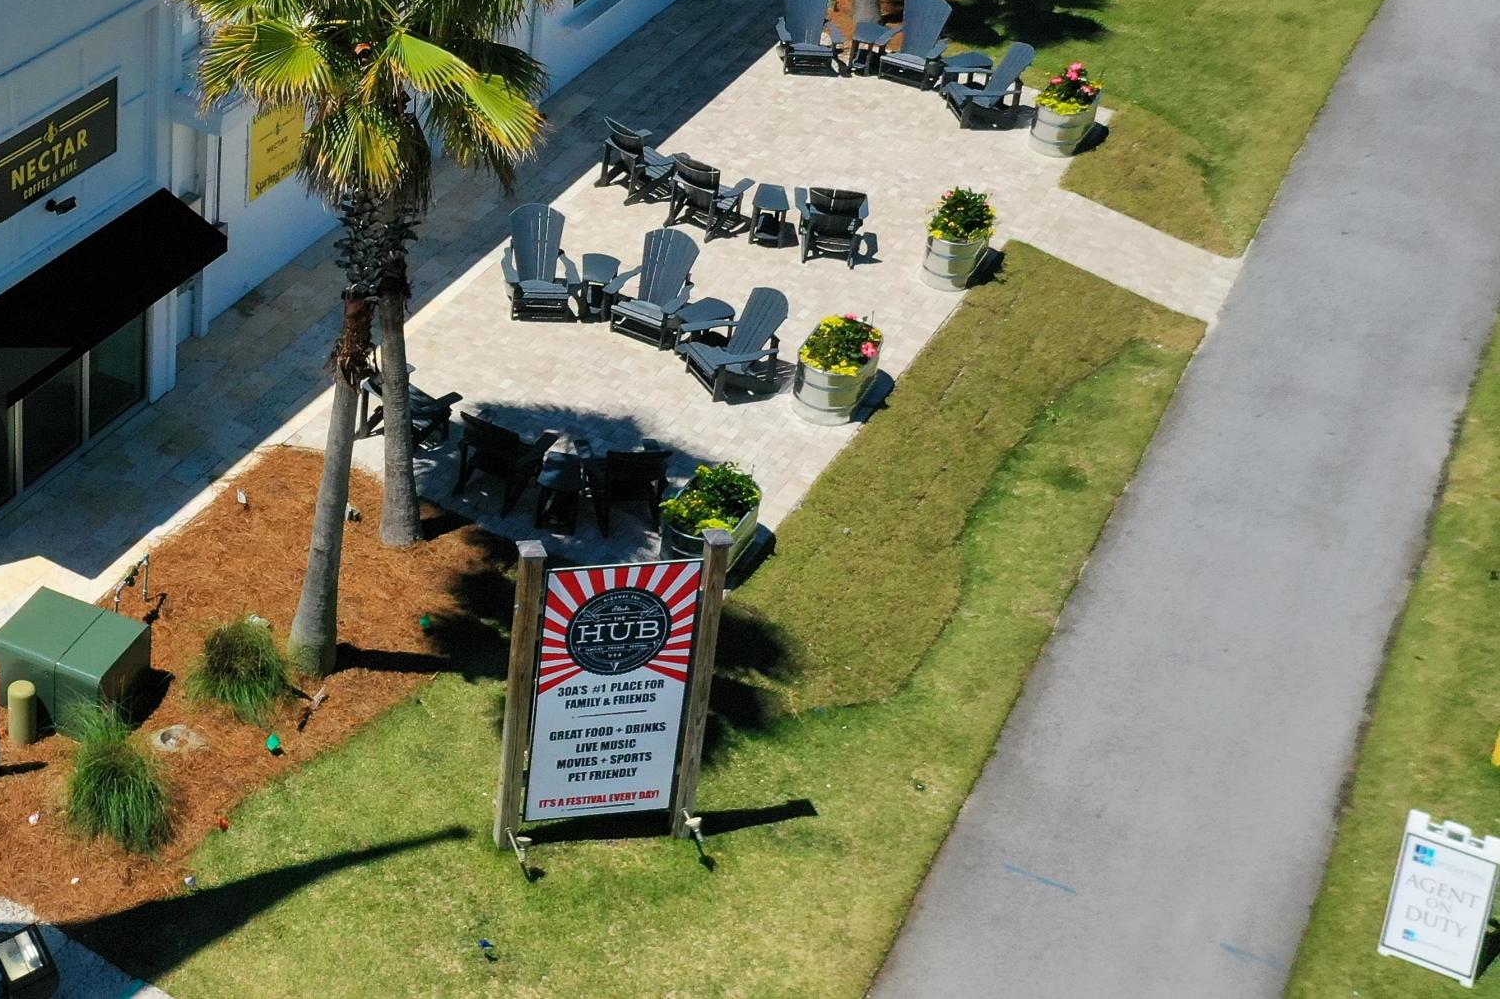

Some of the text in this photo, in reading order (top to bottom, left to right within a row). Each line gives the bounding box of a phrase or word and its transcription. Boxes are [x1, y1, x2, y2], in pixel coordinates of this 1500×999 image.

[10, 128, 88, 191] NECTAR
[23, 159, 77, 200] COFFEE & WINE
[255, 171, 280, 195] Spring
[576, 620, 660, 643] HUB
[557, 679, 665, 697] 30A'S #1 PLACE FOR
[565, 693, 656, 709] FAMILY & FRIENDS
[549, 729, 583, 741] GREAT
[585, 726, 613, 738] FOOD
[625, 722, 667, 734] DRINKS
[576, 738, 636, 753] LIVE MUSIC
[556, 756, 598, 769] MOVIES
[610, 752, 652, 764] SPORTS
[568, 767, 638, 782] PET FRIENDLY
[539, 789, 660, 808] IT'S A FESTIVAL EVERY DAY!
[1405, 873, 1482, 909] AGENT
[1425, 896, 1452, 914] ON
[1405, 904, 1468, 938] DUTY
